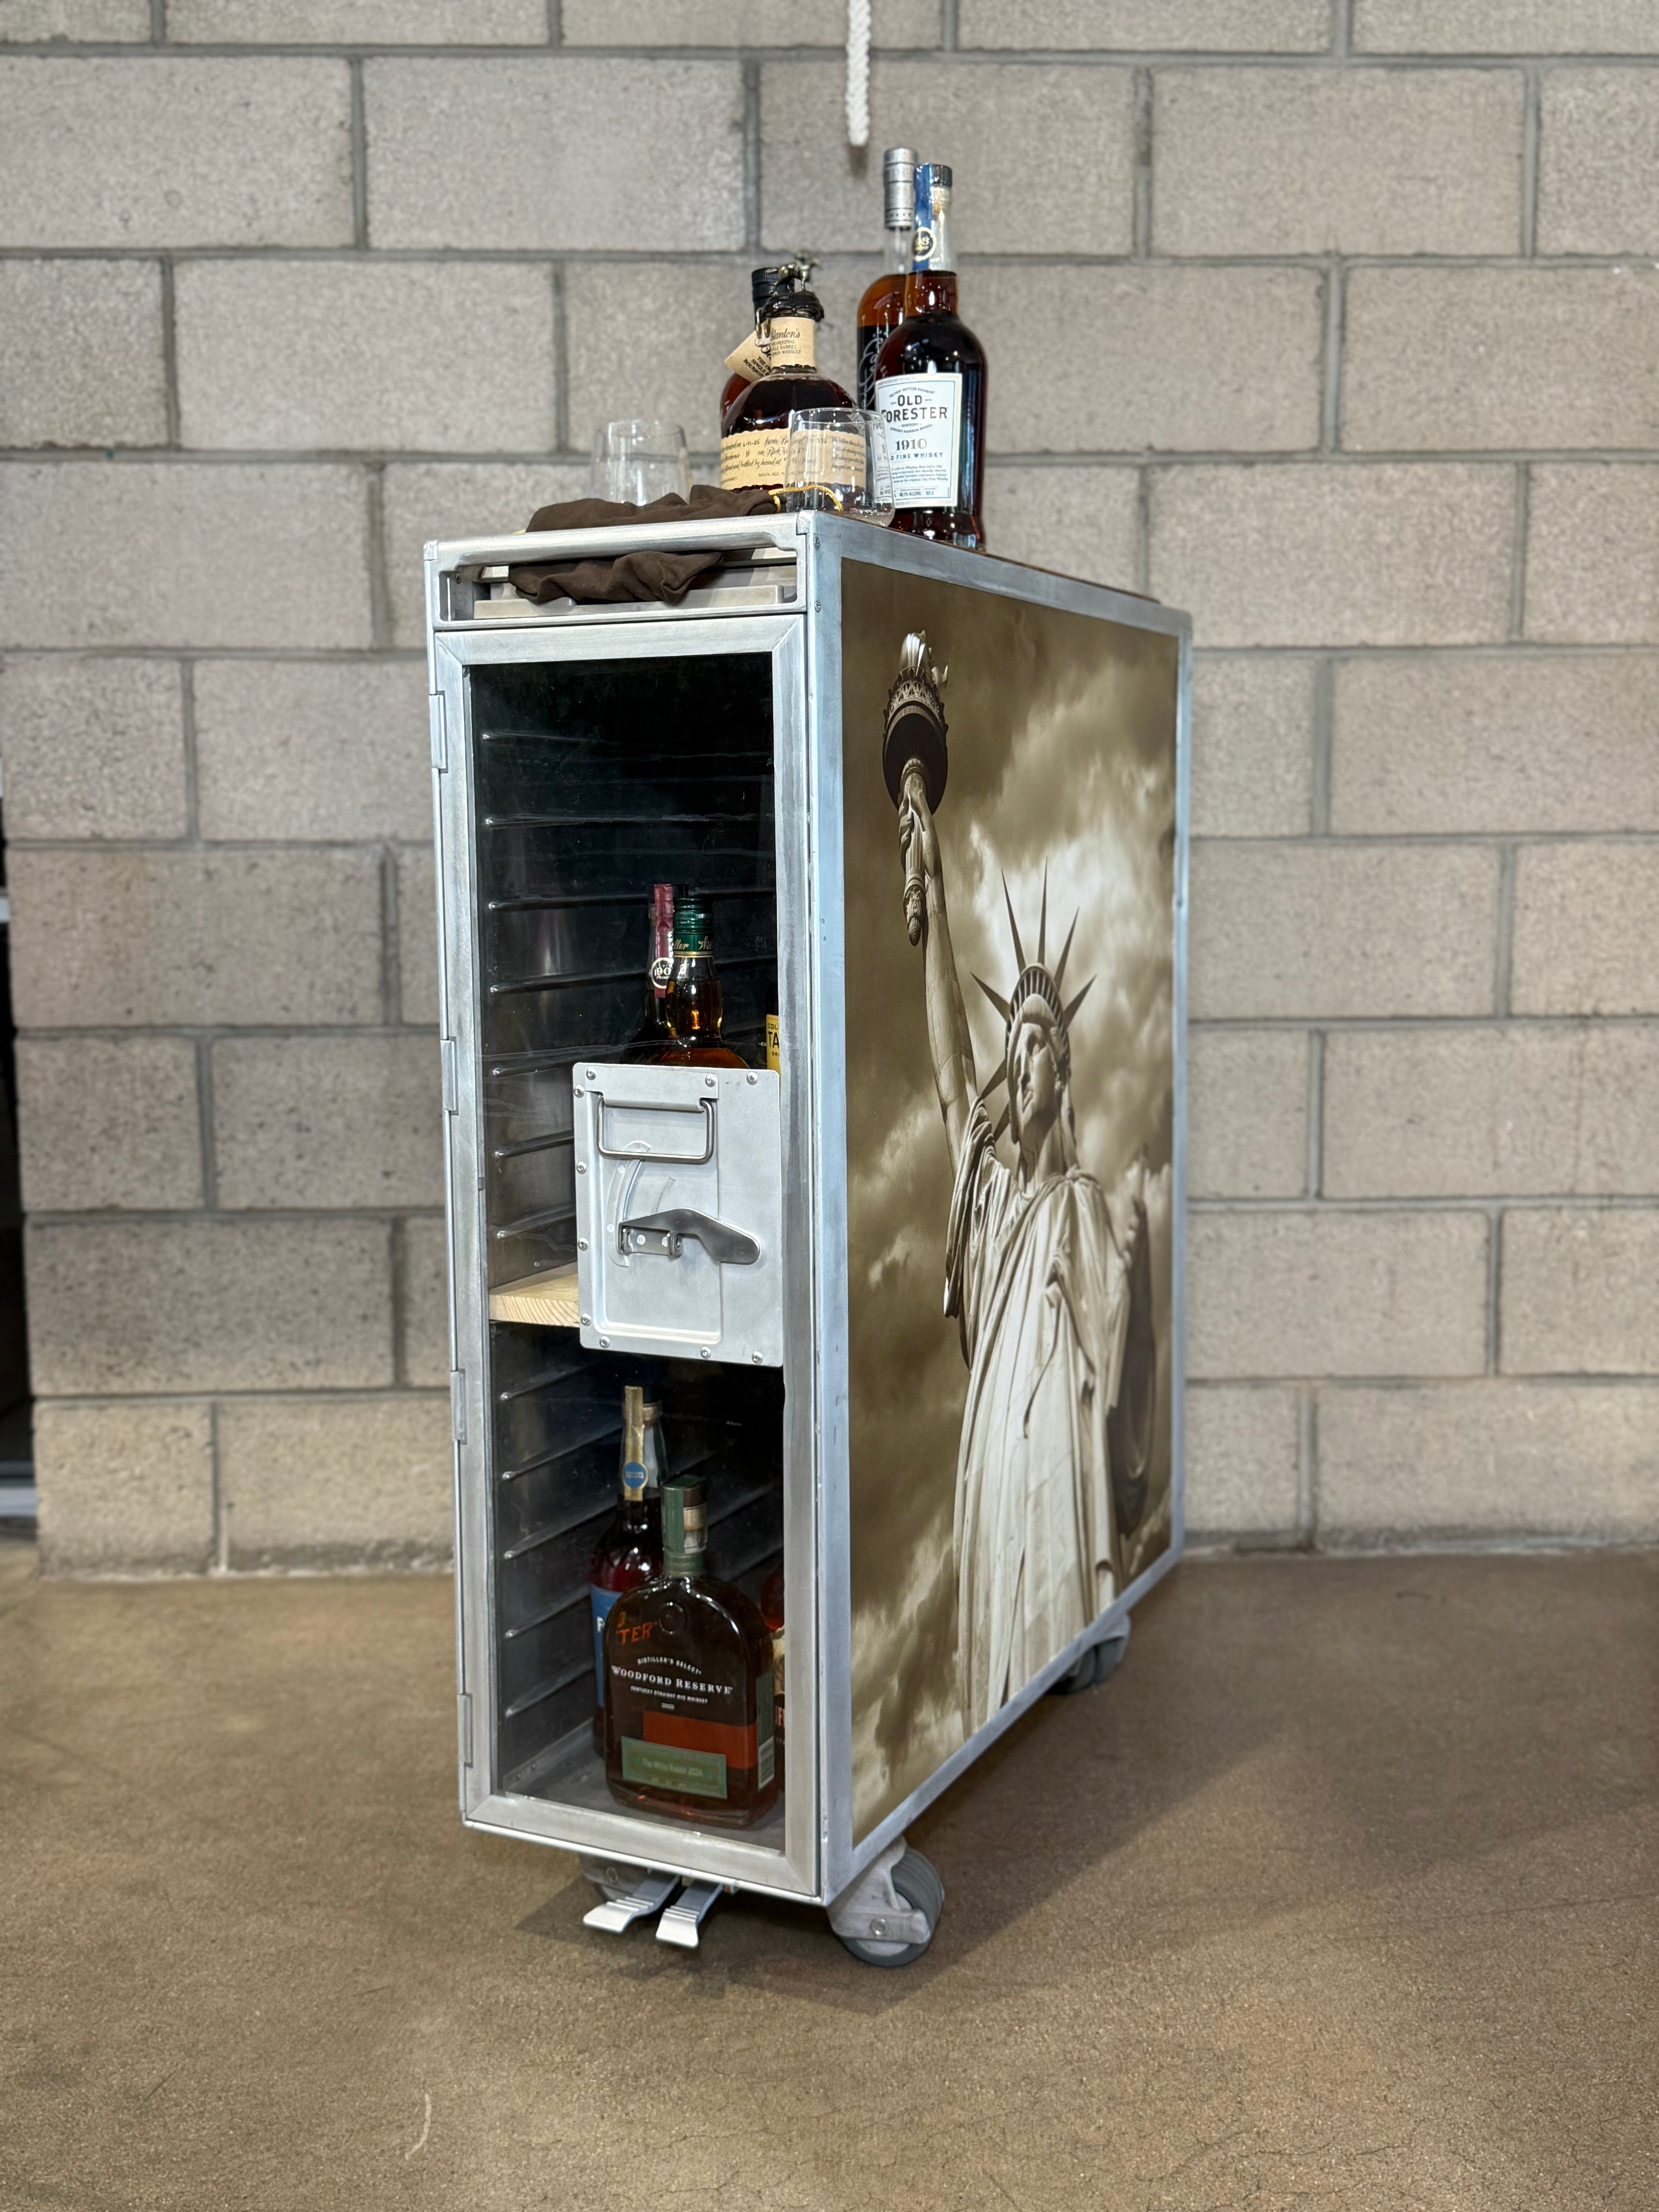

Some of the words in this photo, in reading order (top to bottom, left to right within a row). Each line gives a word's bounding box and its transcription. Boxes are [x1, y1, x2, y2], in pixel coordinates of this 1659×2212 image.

[751, 359, 763, 371] SINGLE
[757, 356, 766, 366] THE
[897, 394, 922, 407] OLD
[881, 406, 948, 423] FORESTER
[895, 438, 927, 451] 1910
[673, 939, 690, 950] ller
[768, 1031, 780, 1049] TA
[637, 1656, 674, 1665] DISTILLER'S
[676, 1659, 700, 1675] SELECT
[611, 1665, 672, 1686] WOODFORD
[676, 1678, 732, 1695] RESERVE
[630, 1685, 653, 1695] KENTUCKY
[654, 1690, 676, 1698] STRAIGHT
